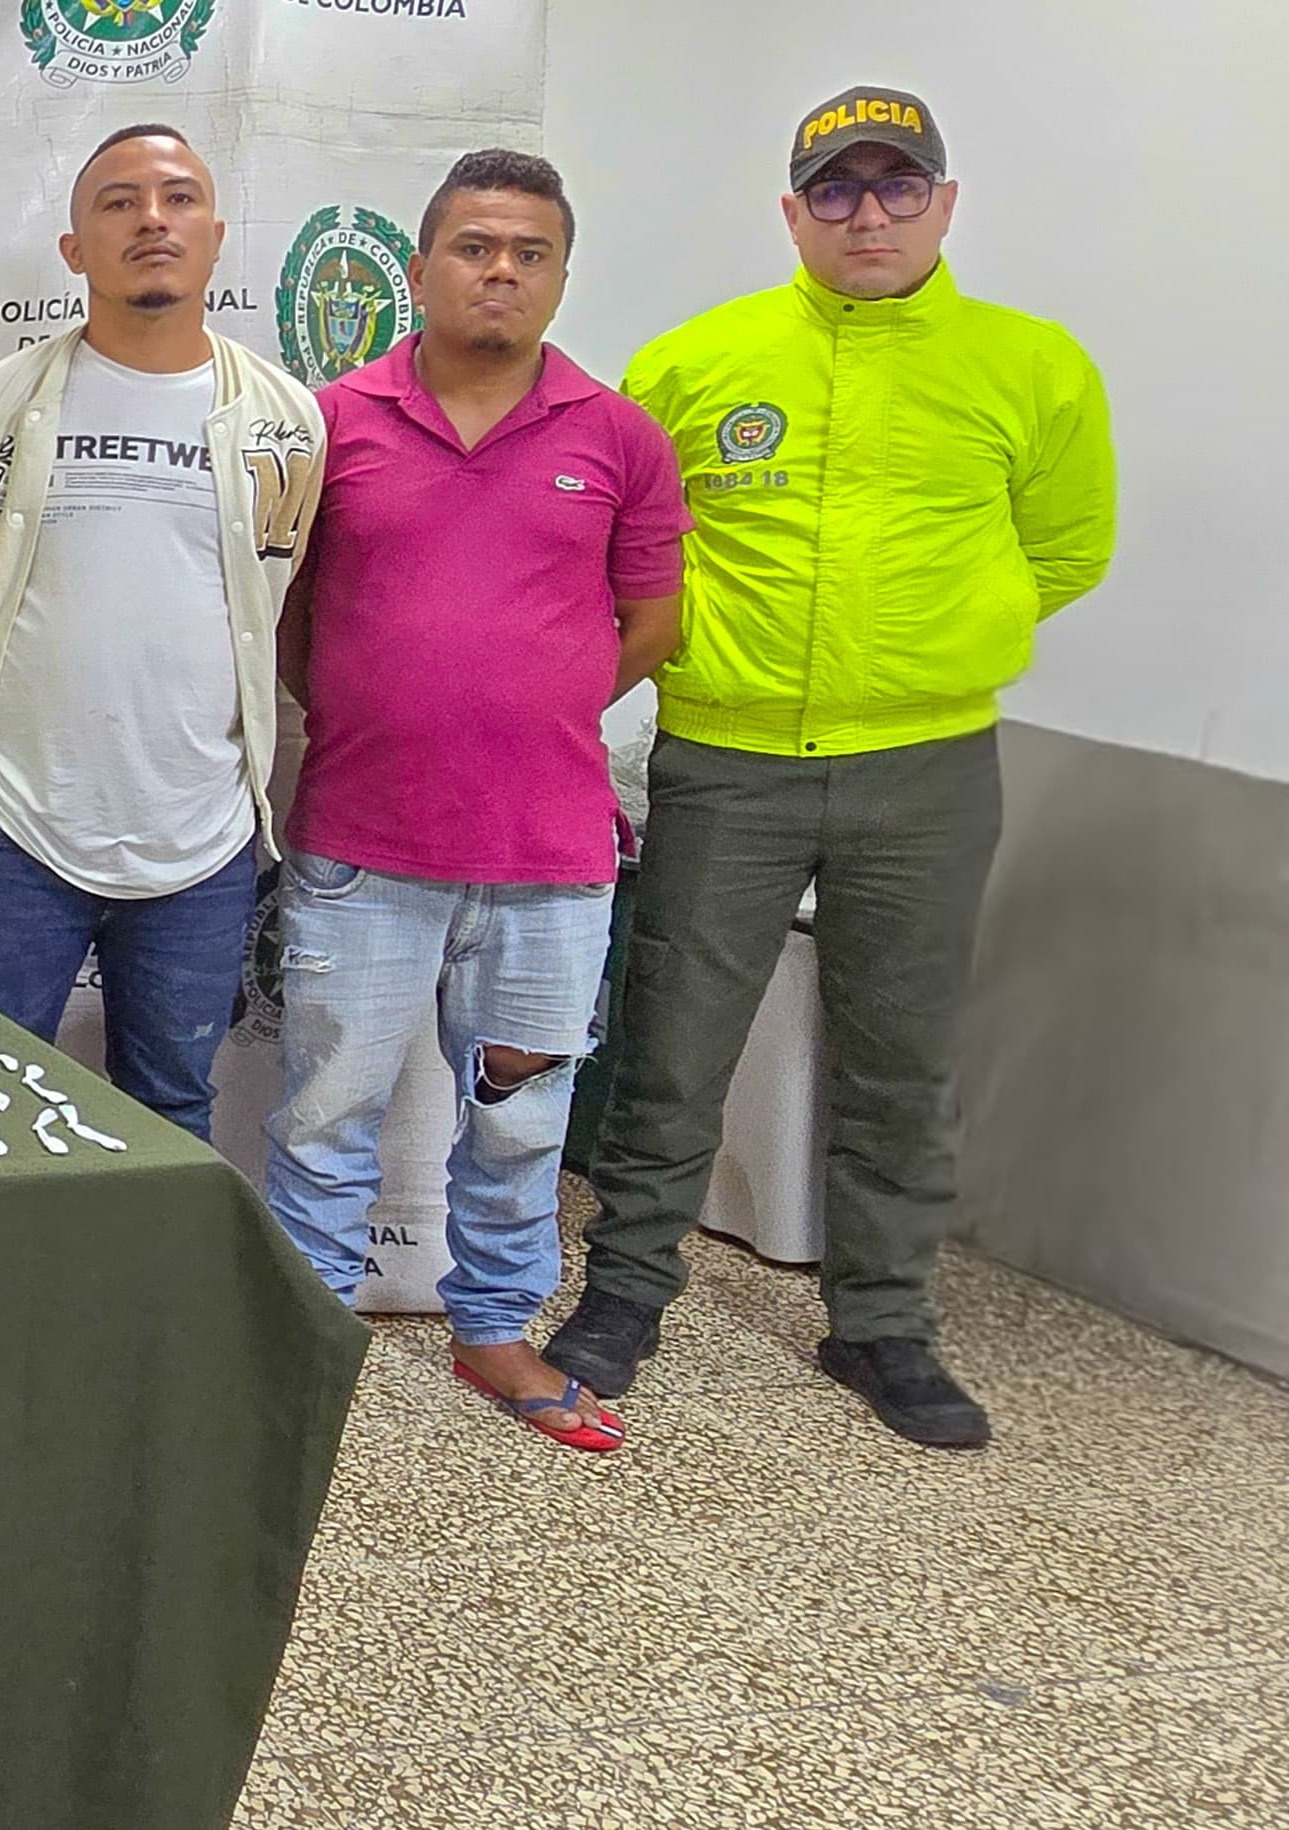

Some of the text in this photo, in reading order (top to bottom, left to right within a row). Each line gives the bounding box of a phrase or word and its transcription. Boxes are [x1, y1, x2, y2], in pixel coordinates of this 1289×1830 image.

[127, 1, 194, 56] NACIONAL
[67, 52, 172, 78] DIOS Y PATRIA
[804, 99, 922, 149] POLICIA
[338, 232, 357, 244] DE
[370, 244, 410, 335] COLOMBIA
[56, 435, 213, 472] TREETWE
